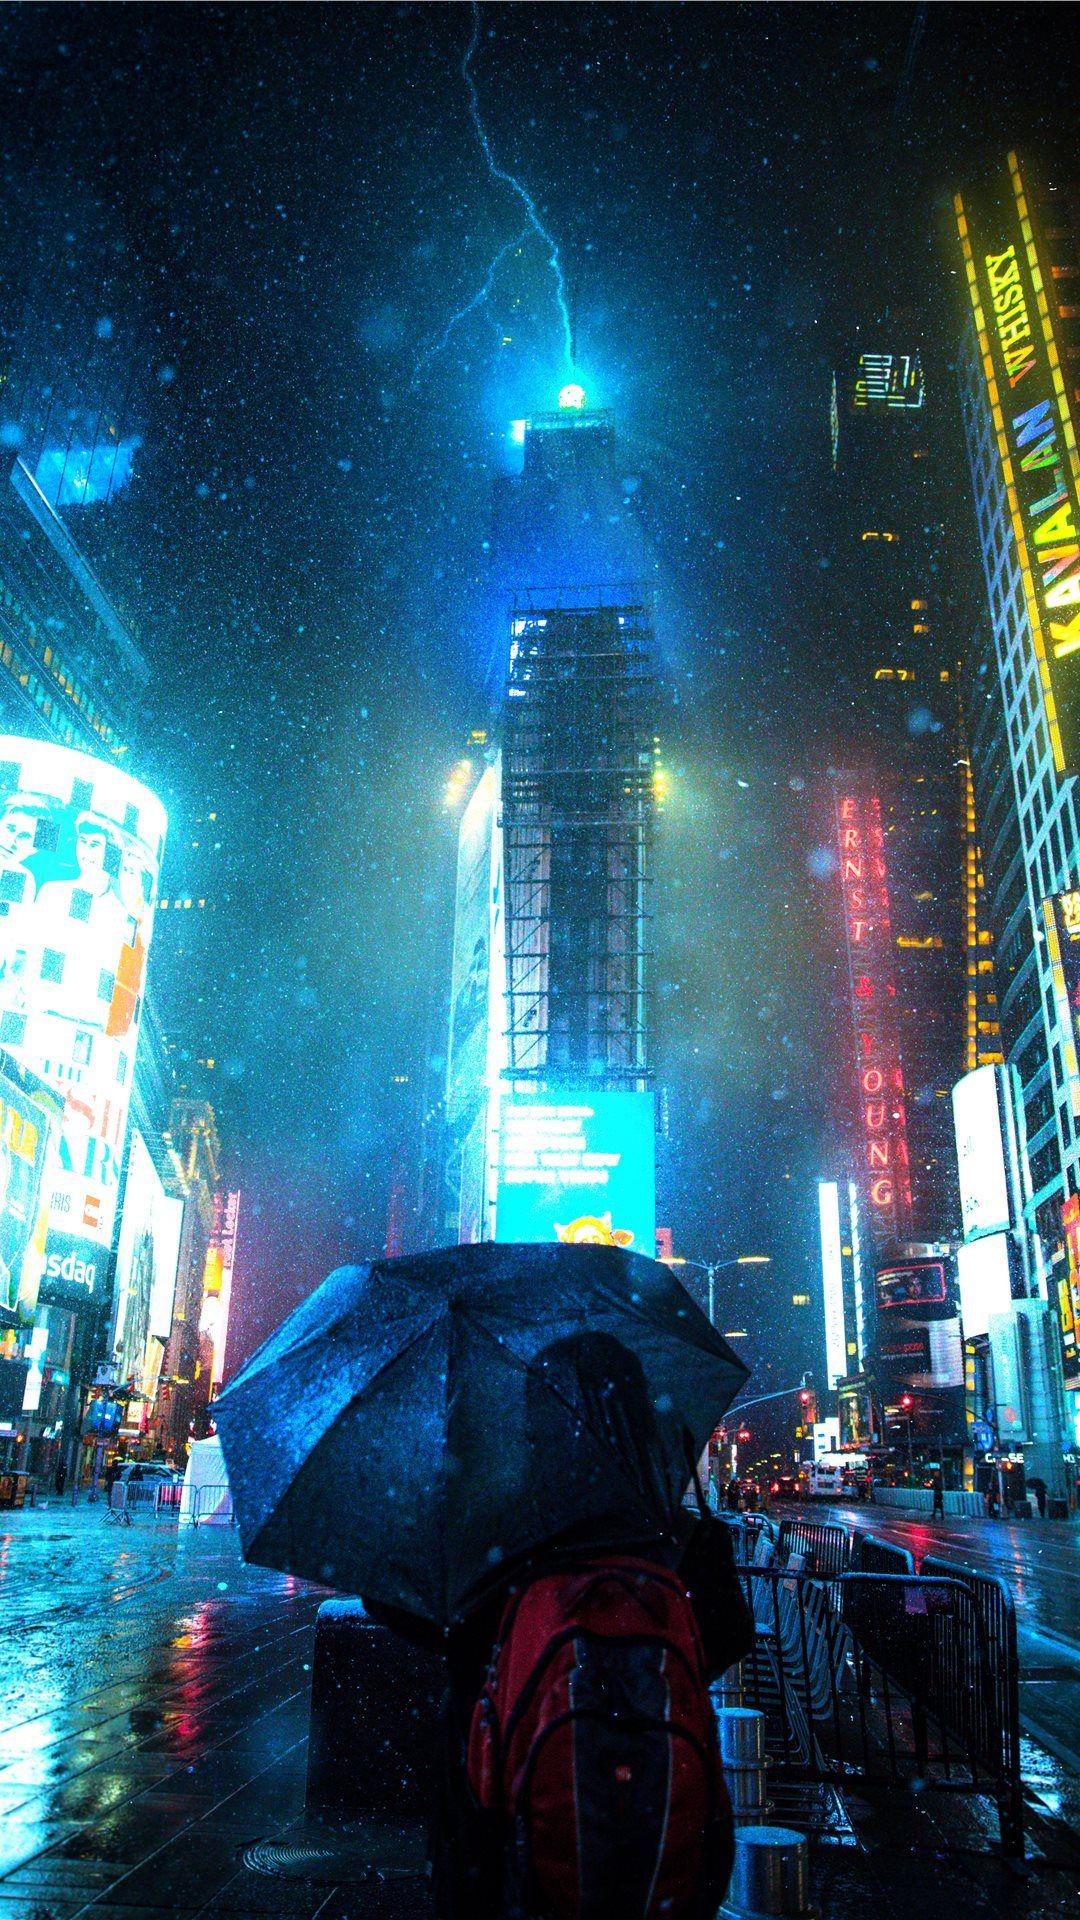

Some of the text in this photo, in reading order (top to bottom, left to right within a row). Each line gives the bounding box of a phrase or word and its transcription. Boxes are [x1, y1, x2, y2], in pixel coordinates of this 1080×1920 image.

[985, 244, 1080, 660] KAVALAN WHISKY
[841, 797, 893, 1205] ERNST & YOUNG
[41, 1250, 96, 1294] sdaq
